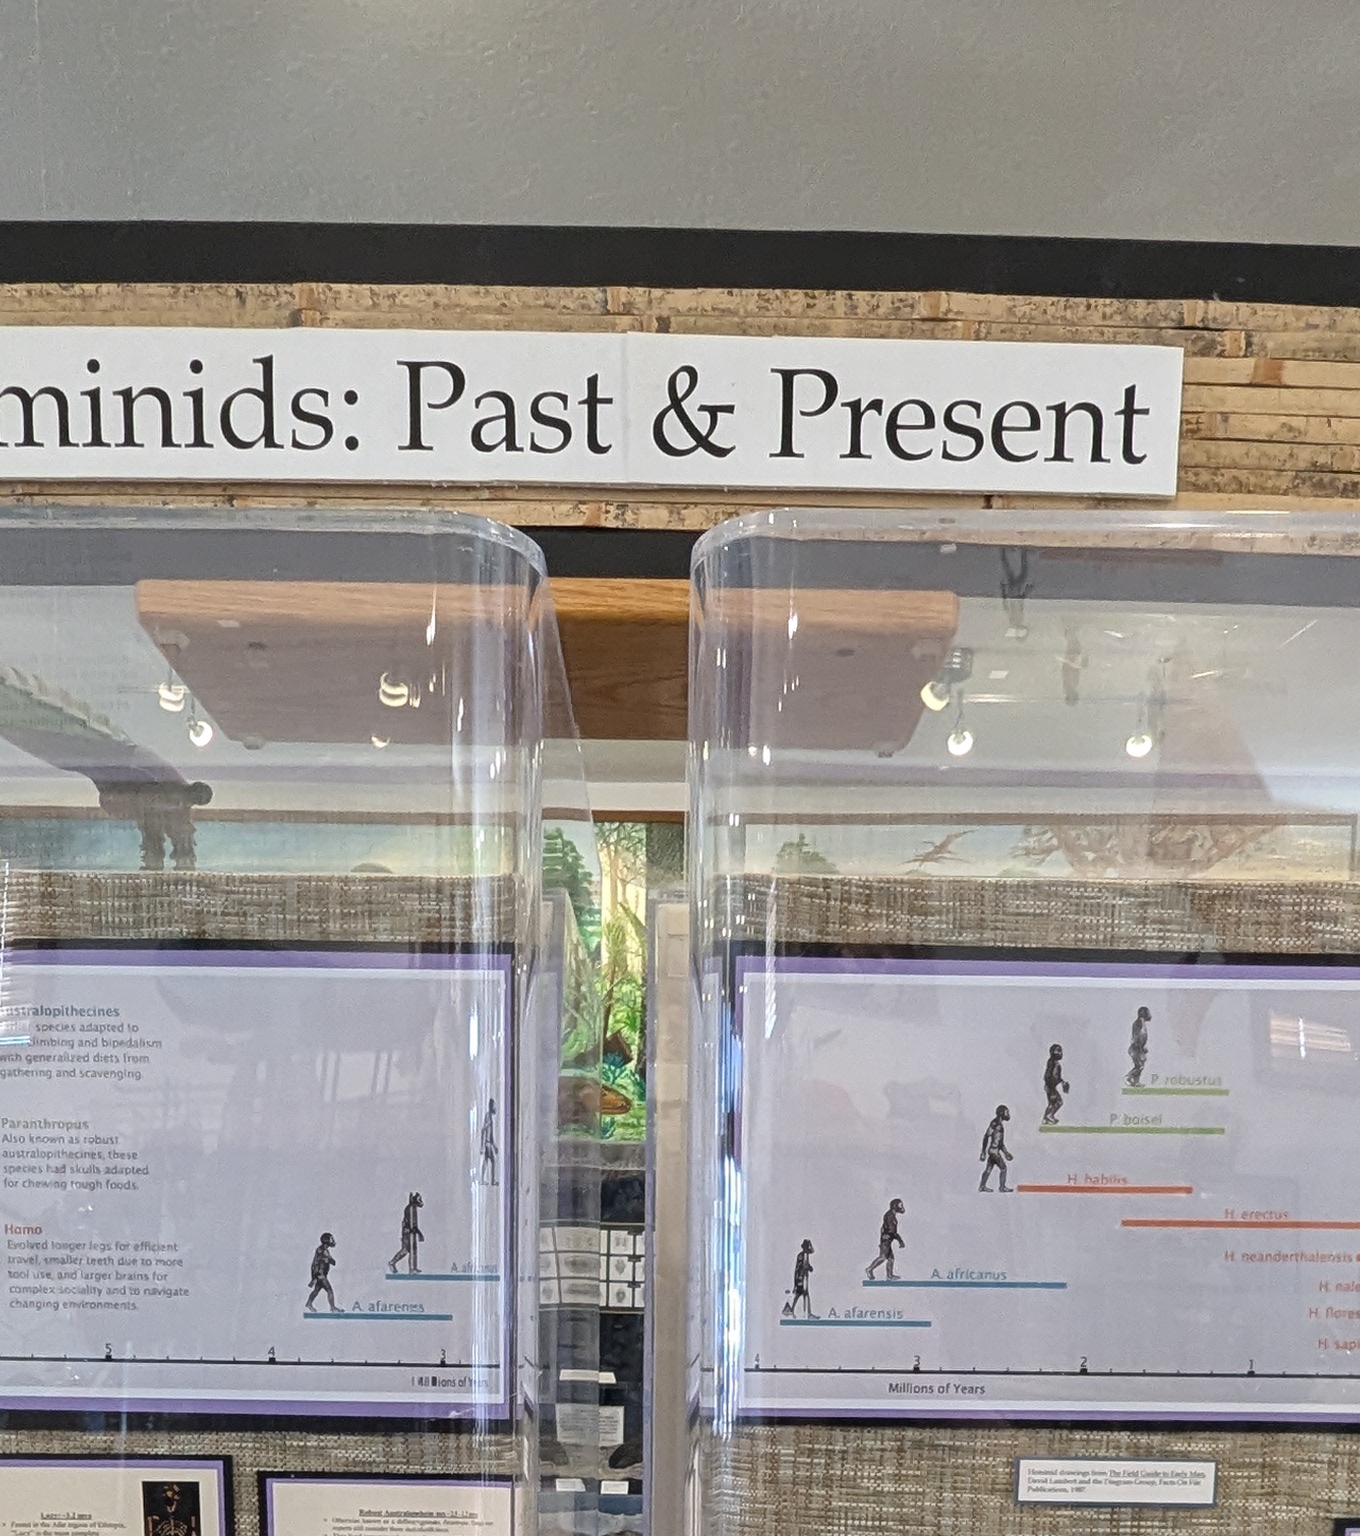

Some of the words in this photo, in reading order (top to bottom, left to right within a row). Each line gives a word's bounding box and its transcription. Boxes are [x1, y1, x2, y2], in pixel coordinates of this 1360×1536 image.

[398, 360, 614, 456] Past
[652, 364, 735, 458] &
[771, 367, 1150, 465] Present
[0, 1004, 120, 1018] ustralopithecines
[35, 1022, 75, 1031] species
[79, 1021, 124, 1033] adapted
[127, 1022, 139, 1032] to
[77, 1036, 98, 1047] and
[101, 1037, 161, 1048] bipedalism
[25, 1051, 89, 1064] generalized
[92, 1051, 119, 1063] diets
[123, 1052, 149, 1063] from
[0, 1067, 52, 1079] gathering
[55, 1067, 76, 1077] and
[79, 1069, 141, 1080] scavenging
[1, 1117, 89, 1129] Paranthropus
[1, 1132, 25, 1143] Also
[28, 1133, 65, 1143] known
[67, 1135, 80, 1144] as
[83, 1134, 118, 1144] robust
[107, 1149, 137, 1159] these
[3, 1164, 43, 1174] species
[46, 1163, 66, 1173] had
[69, 1163, 101, 1174] skulls
[103, 1164, 149, 1175] adapted
[3, 1176, 18, 1187] for
[21, 1178, 67, 1189] chewing
[70, 1179, 102, 1191] tough
[105, 1178, 138, 1190] foods.
[1240, 1209, 1288, 1220] erectus
[4, 1223, 42, 1234] Homo
[7, 1238, 48, 1249] Evolved
[51, 1240, 86, 1252] longer
[88, 1239, 112, 1252] legs
[114, 1240, 130, 1251] for
[132, 1240, 178, 1252] efficient
[43, 1253, 83, 1265] smaller
[85, 1255, 114, 1266] teeth
[117, 1256, 137, 1265] due
[140, 1257, 152, 1266] to
[154, 1257, 183, 1266] more
[1241, 1251, 1355, 1262] neanderthalensis
[7, 1268, 29, 1278] tool
[57, 1268, 77, 1280] and
[81, 1268, 112, 1281] larger
[115, 1269, 149, 1280] brains
[152, 1270, 168, 1281] for
[930, 1268, 943, 1280] A.
[946, 1268, 1007, 1280] africanus
[9, 1284, 55, 1294] complex
[105, 1284, 126, 1295] and
[128, 1285, 140, 1295] to
[143, 1286, 189, 1298] navigate
[9, 1299, 59, 1310] changing
[827, 1306, 840, 1319] A.
[844, 1307, 903, 1318] afarensis
[105, 1343, 112, 1354] 5
[267, 1346, 276, 1358] 4
[440, 1349, 446, 1360] 3
[754, 1354, 760, 1364] 4
[913, 1355, 921, 1367] 3
[1080, 1356, 1088, 1368] 2
[1249, 1359, 1254, 1371] 1
[888, 1382, 934, 1393] Millions
[937, 1381, 950, 1393] of
[953, 1383, 985, 1394] Years
